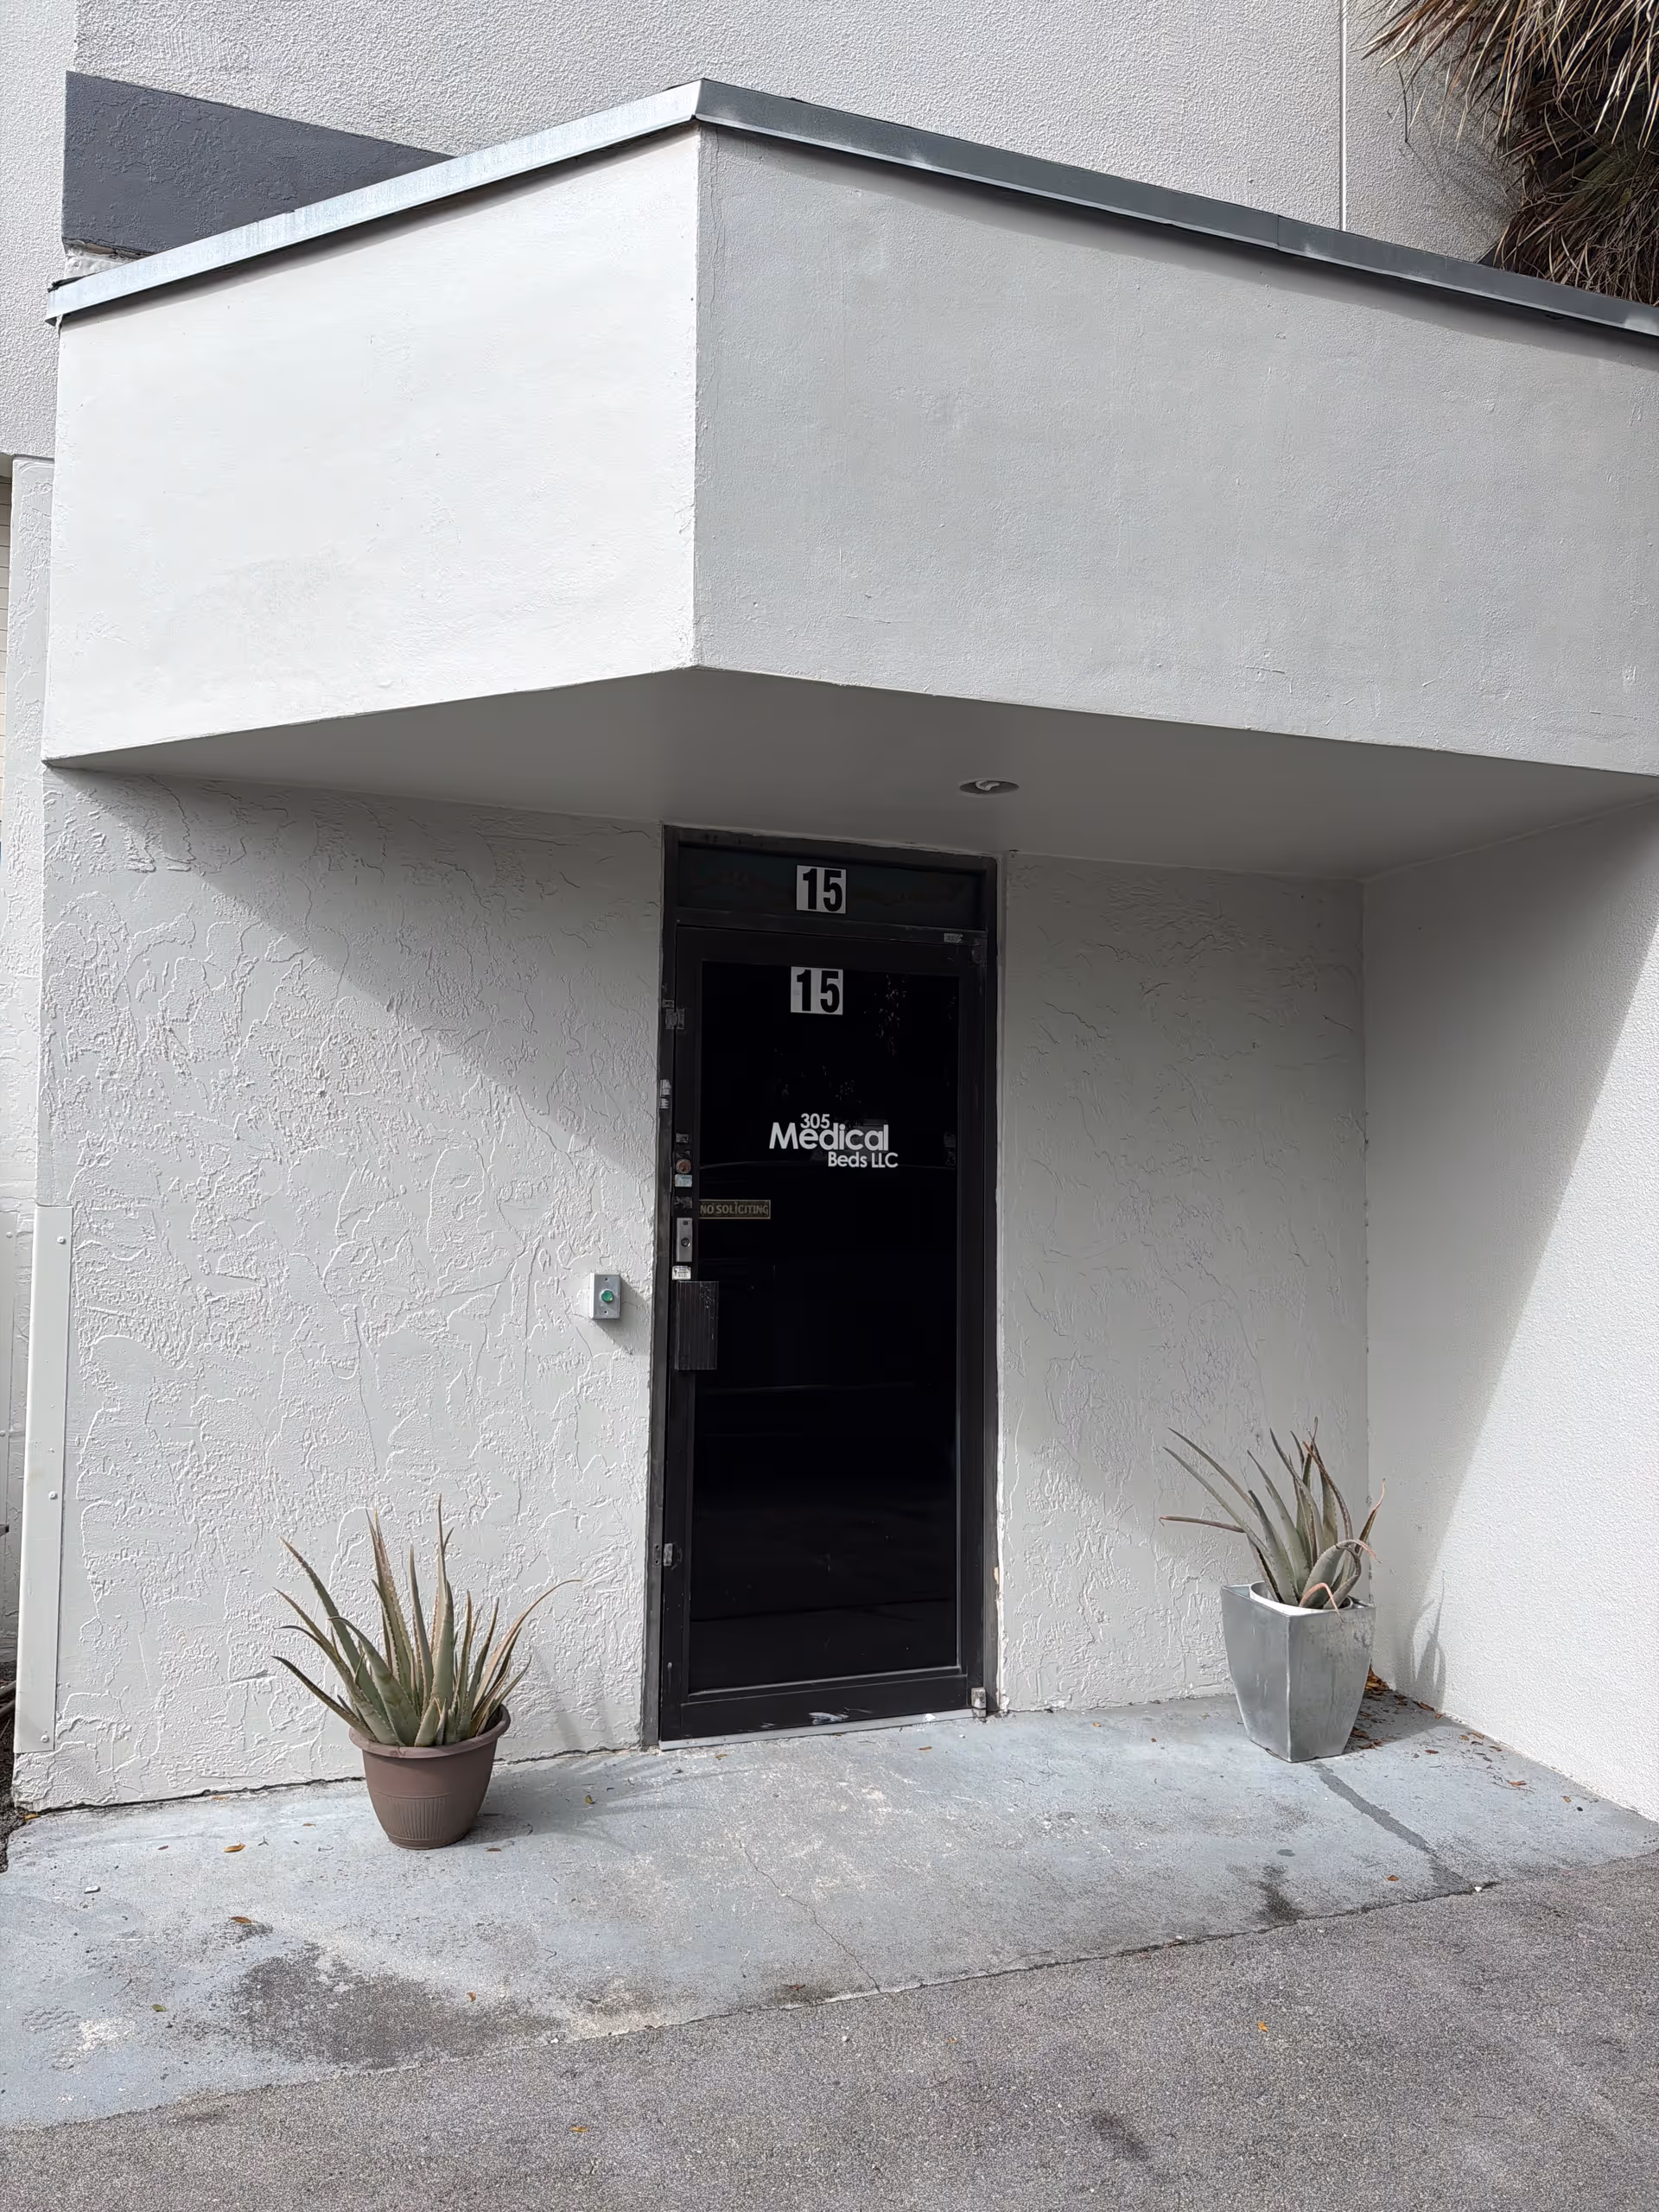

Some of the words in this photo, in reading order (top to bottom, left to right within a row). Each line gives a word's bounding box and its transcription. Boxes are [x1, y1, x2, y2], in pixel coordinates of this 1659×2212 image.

[803, 868, 843, 912] 15
[796, 969, 840, 1014] 15
[800, 1113, 830, 1129] 305
[768, 1122, 889, 1152] Medical
[828, 1151, 868, 1167] Beds
[871, 1152, 899, 1168] LLC
[700, 1204, 715, 1215] NO
[715, 1204, 769, 1215] SOLICITING
